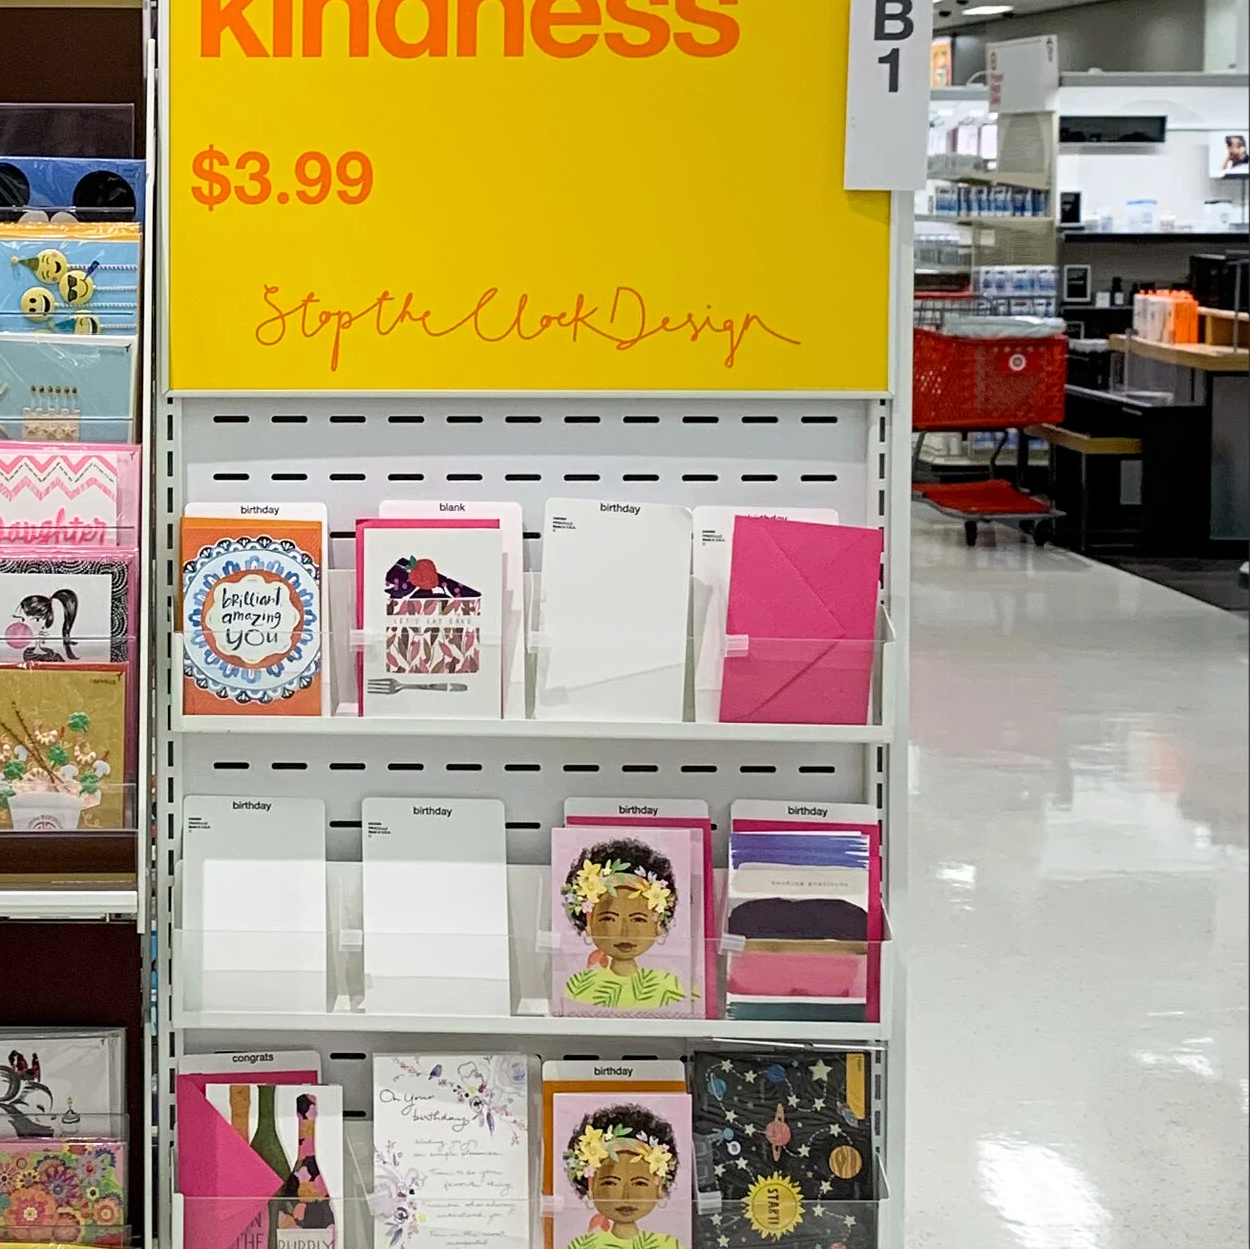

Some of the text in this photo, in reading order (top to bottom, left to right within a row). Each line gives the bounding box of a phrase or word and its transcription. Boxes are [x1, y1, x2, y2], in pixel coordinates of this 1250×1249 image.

[877, 48, 902, 93] 1
[190, 144, 374, 212] $3.99
[255, 284, 801, 372] Stop the Clock Design
[240, 505, 280, 516] birthday
[439, 503, 466, 512] blank
[600, 503, 641, 515] birthday
[222, 611, 281, 629] amazing
[226, 628, 278, 651] you
[232, 801, 272, 812] birthday
[413, 806, 453, 817] birthday
[618, 805, 658, 816] birthday
[787, 806, 828, 817] birthday
[232, 1052, 274, 1063] congrats
[594, 1065, 633, 1077] birthday
[412, 1109, 479, 1132] birthday
